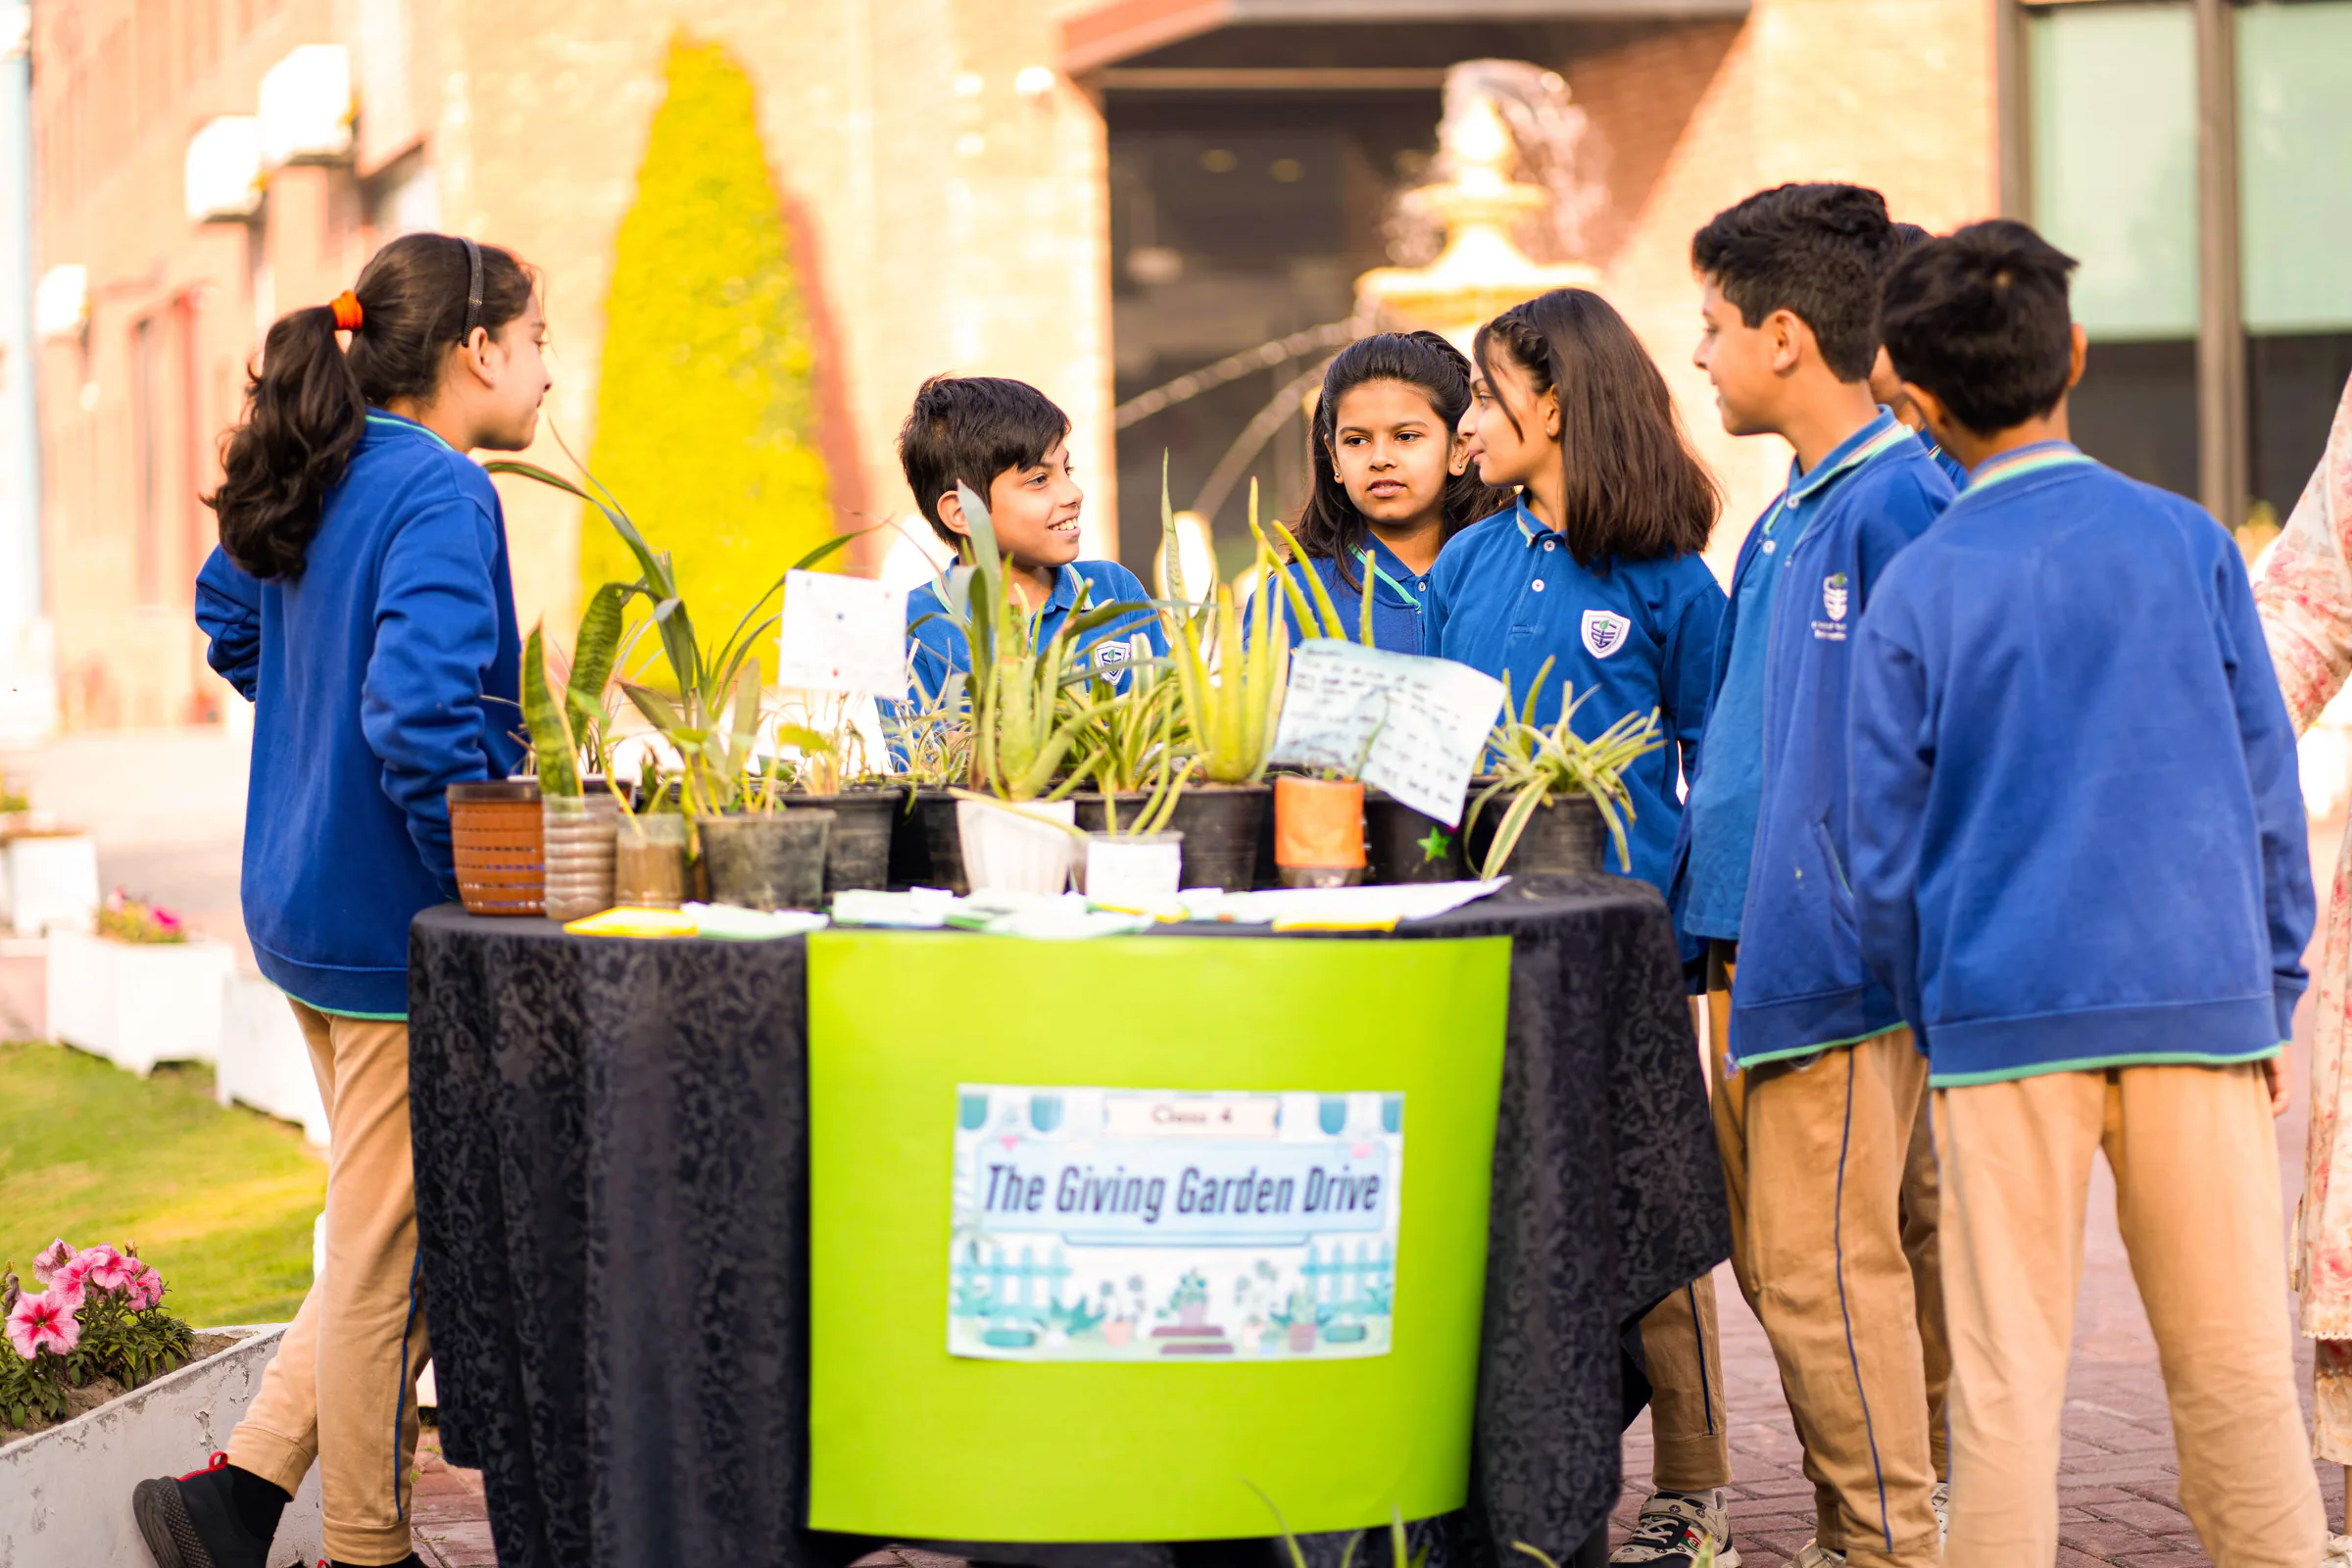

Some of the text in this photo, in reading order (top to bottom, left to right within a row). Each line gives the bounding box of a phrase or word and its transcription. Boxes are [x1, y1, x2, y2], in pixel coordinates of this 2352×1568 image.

[986, 1164, 1380, 1224] The Giving Garden Drive
